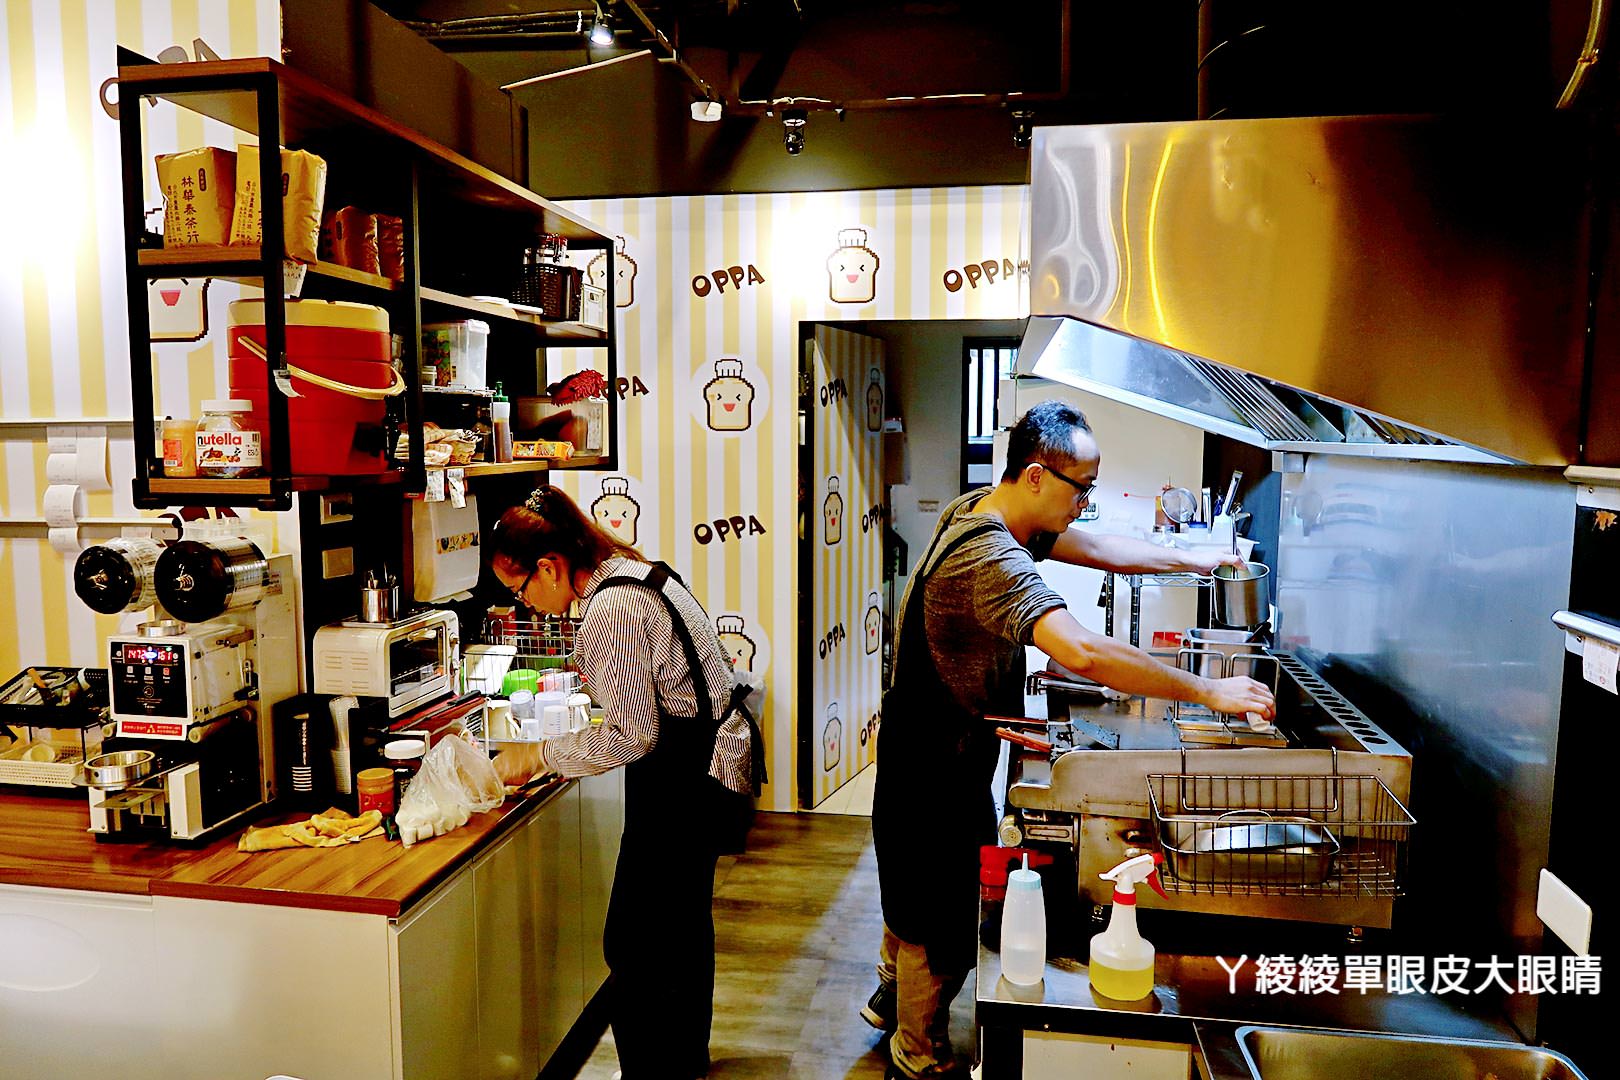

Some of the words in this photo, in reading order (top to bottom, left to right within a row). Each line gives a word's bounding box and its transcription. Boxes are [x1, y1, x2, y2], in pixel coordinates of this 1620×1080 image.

[692, 264, 765, 297] OPPA
[820, 377, 848, 407] OPPA
[197, 432, 242, 446] nutella
[693, 514, 766, 545] OPPA
[819, 622, 846, 660] OPPA
